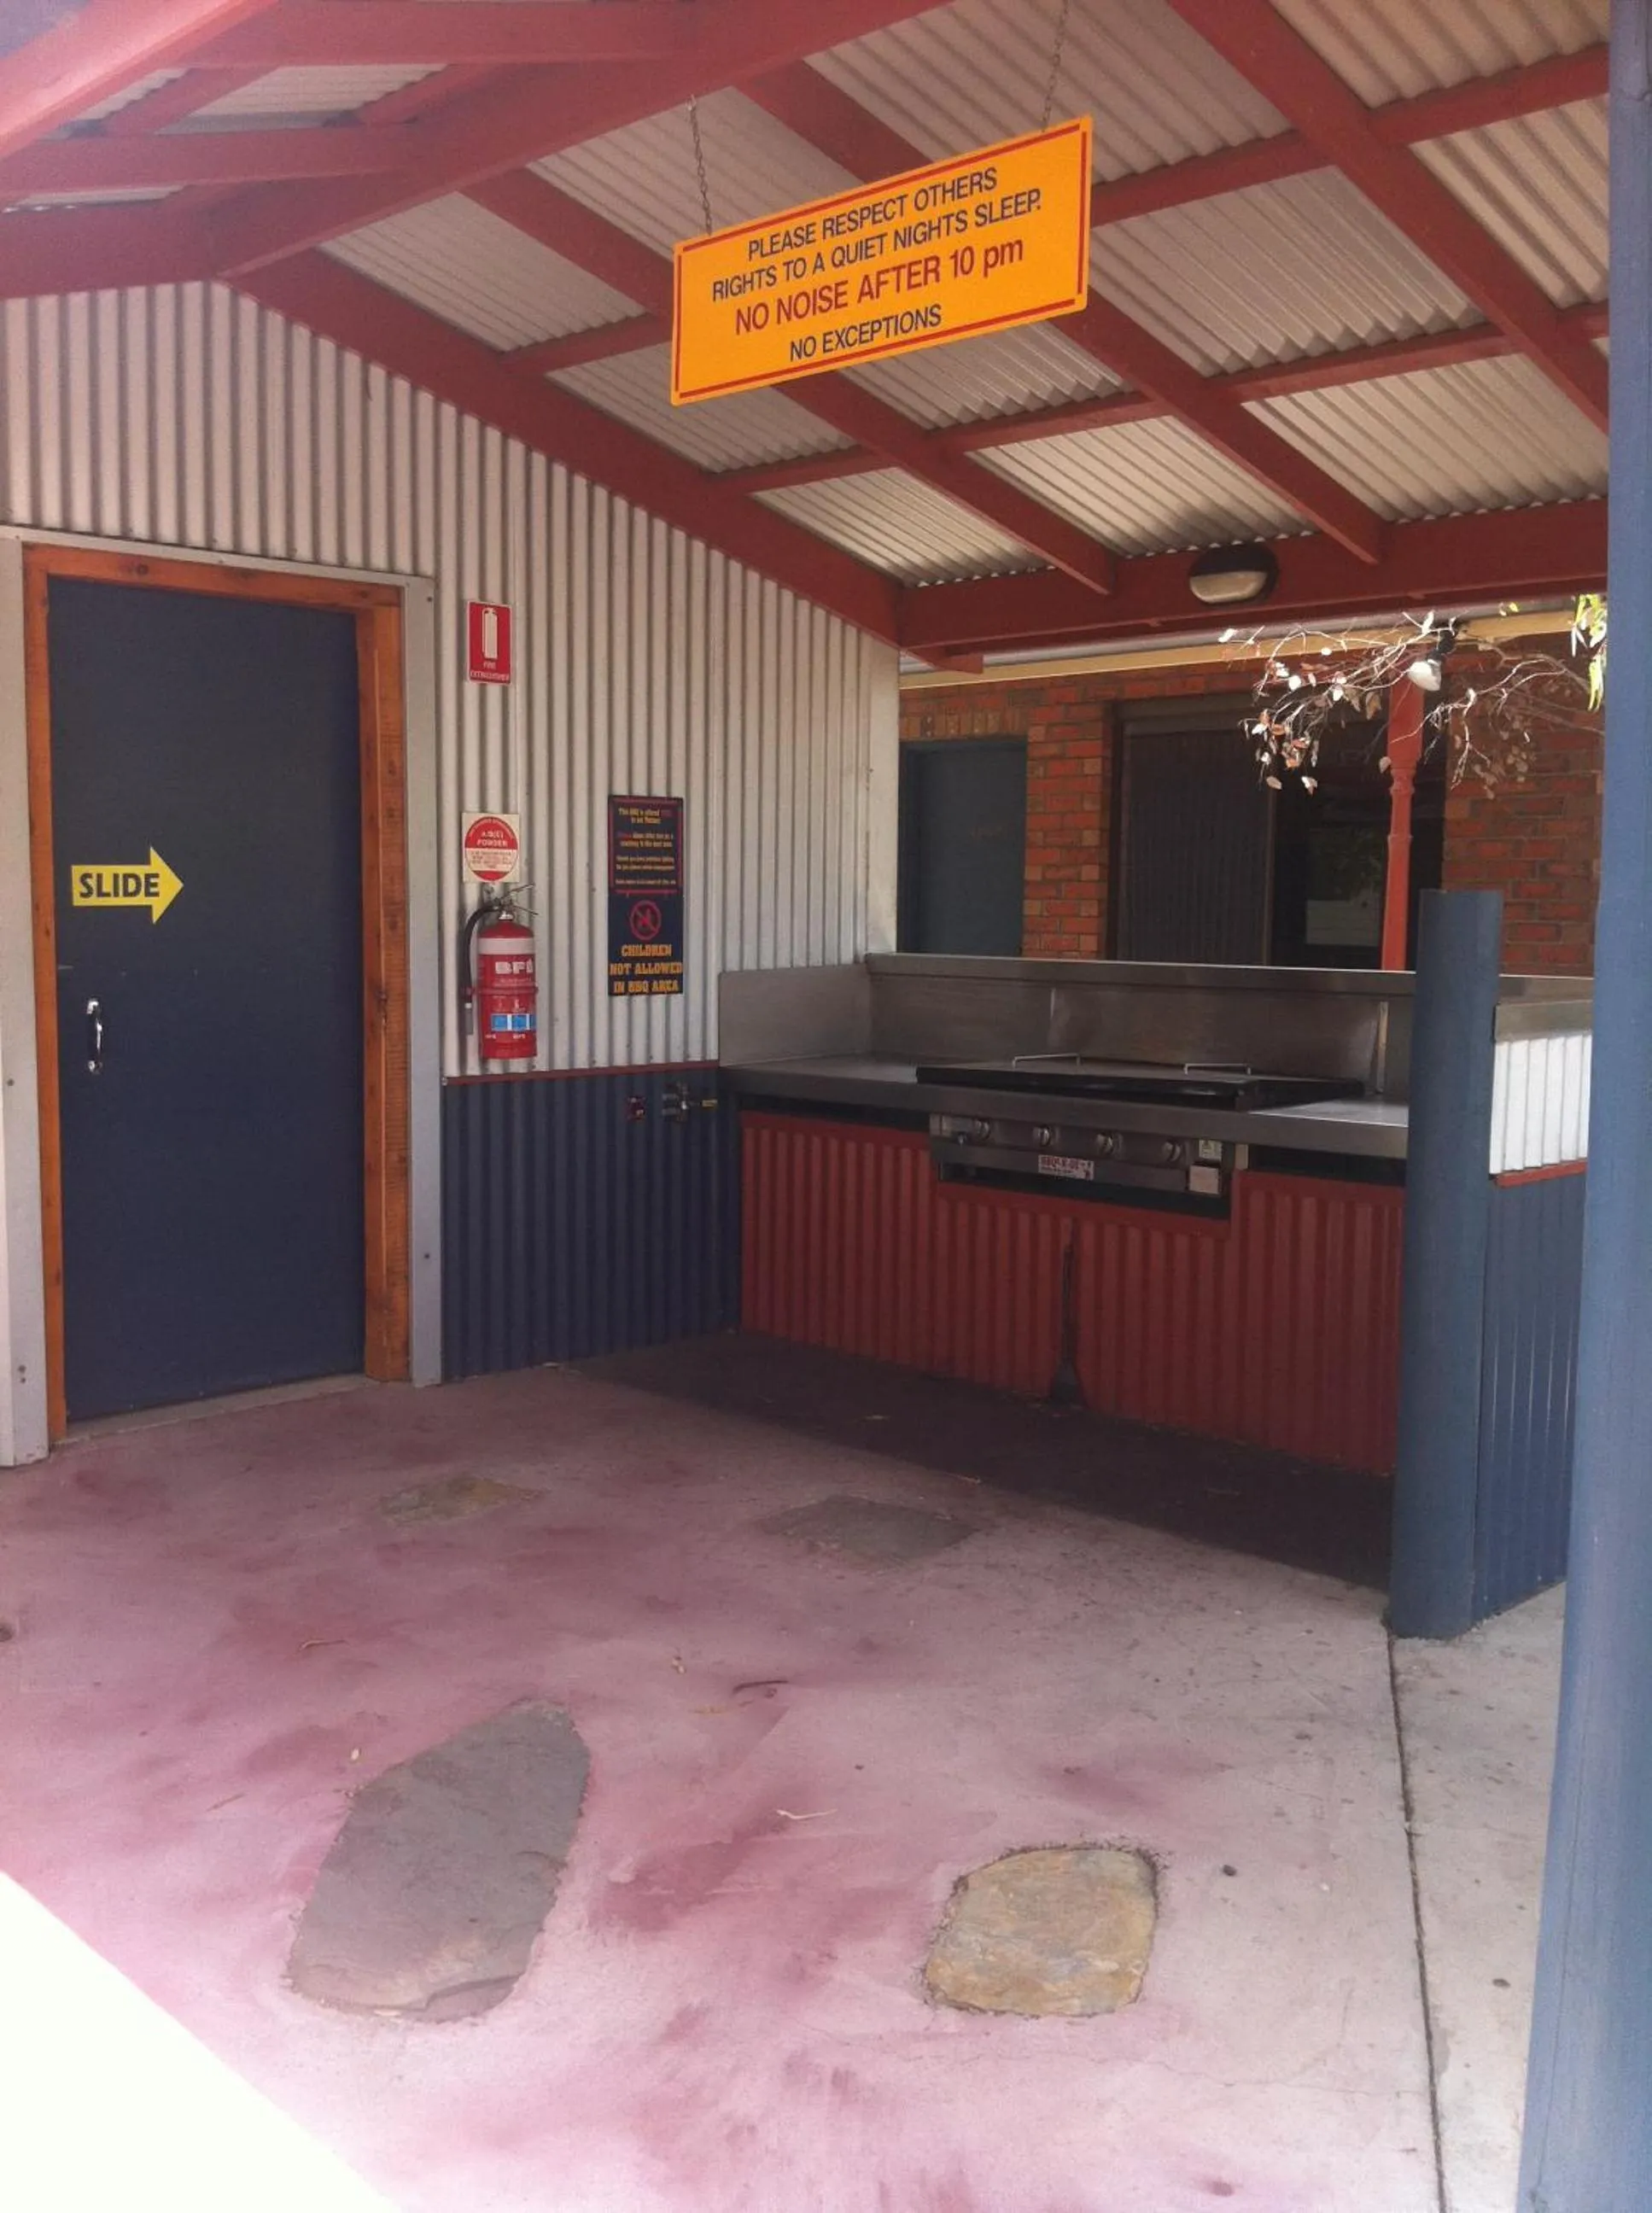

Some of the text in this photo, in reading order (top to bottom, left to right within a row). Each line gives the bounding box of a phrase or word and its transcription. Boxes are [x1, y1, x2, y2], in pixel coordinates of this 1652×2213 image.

[748, 166, 997, 261] PLEASE RESPECT OTHERS
[712, 188, 1042, 301] RIGHTS TO A QUIET NIGHTS SLEEP.
[735, 239, 1024, 335] NO NOISE AFTER 10 pm
[790, 304, 942, 362] NO EXCEPTIONS
[79, 873, 161, 898] SLIDE
[610, 961, 683, 976] NOT ALLOWED
[622, 943, 673, 957] CHILDREN
[614, 981, 625, 994] IN
